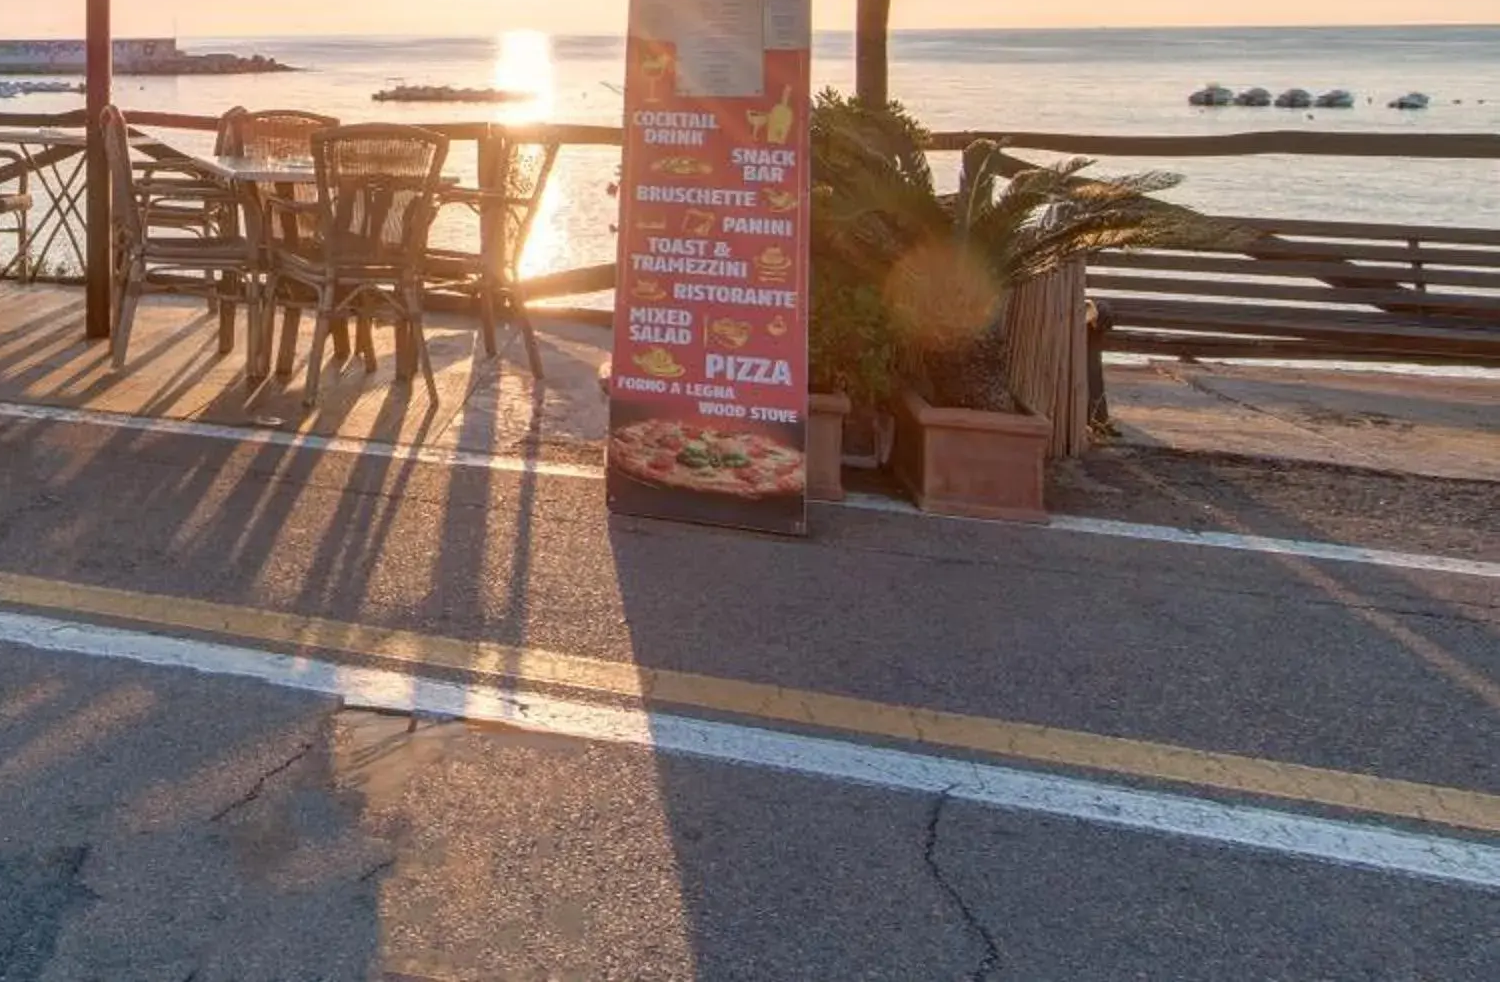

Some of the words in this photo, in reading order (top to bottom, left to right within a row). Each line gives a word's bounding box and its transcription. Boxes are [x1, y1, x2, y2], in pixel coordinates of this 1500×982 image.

[633, 110, 718, 129] COCKTAIL
[644, 128, 703, 145] DRINK
[732, 148, 795, 165] SNACK
[743, 165, 784, 183] BAR
[637, 185, 757, 207] BRUSCHETTE
[723, 217, 792, 236] PANINI
[648, 237, 708, 256] TOAST
[714, 241, 731, 258] &
[631, 254, 747, 278] TRAMEZZINI
[674, 284, 797, 307] RISTORANTE
[630, 308, 692, 326] MIXED
[629, 325, 692, 344] SALAD
[705, 353, 792, 386] PIZZA
[618, 377, 666, 393] FORNO
[670, 380, 681, 394] A
[686, 383, 736, 399] LEGNA
[699, 401, 746, 417] WOOD
[750, 407, 797, 423] STOVE
